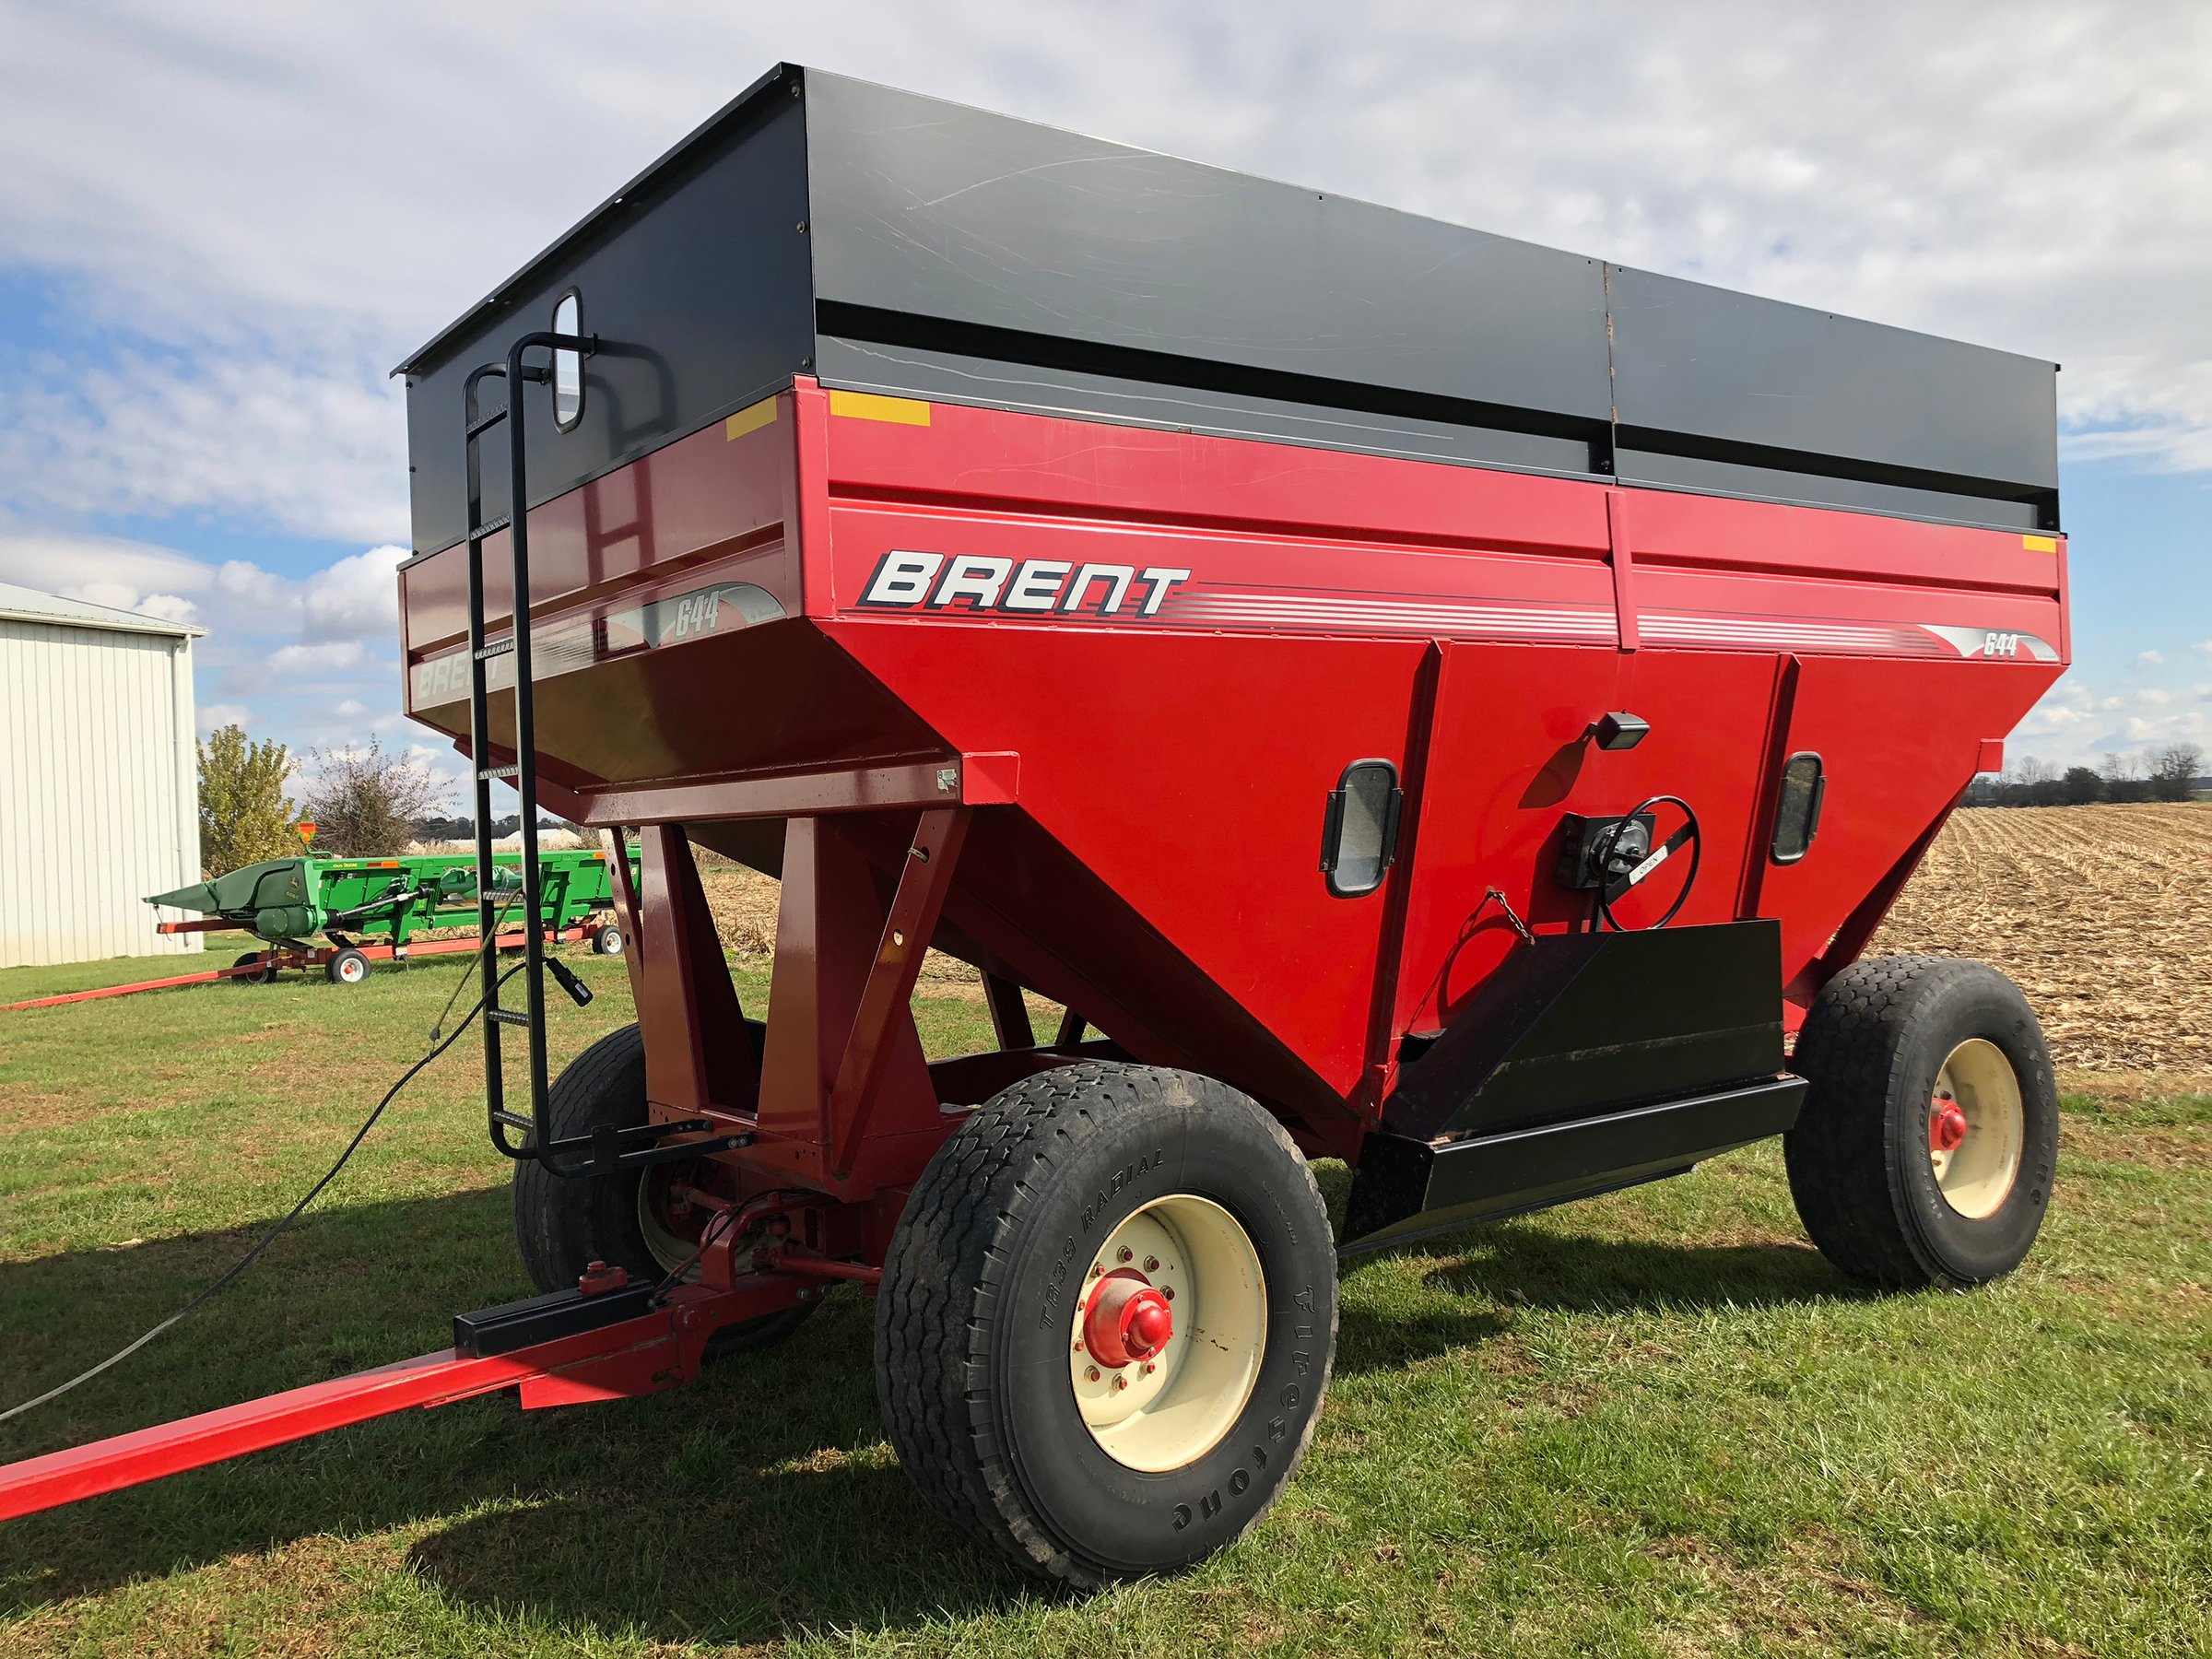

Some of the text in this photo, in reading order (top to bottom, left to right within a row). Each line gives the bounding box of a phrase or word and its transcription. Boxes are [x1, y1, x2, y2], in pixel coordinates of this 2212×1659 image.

[857, 549, 1193, 618] BRENT
[676, 590, 720, 638] 644
[1983, 632, 2018, 657] 644
[1639, 856, 1659, 875] OPEN
[1080, 1148, 1164, 1234] RADIAL
[1171, 1284, 1315, 1534] Firestone
